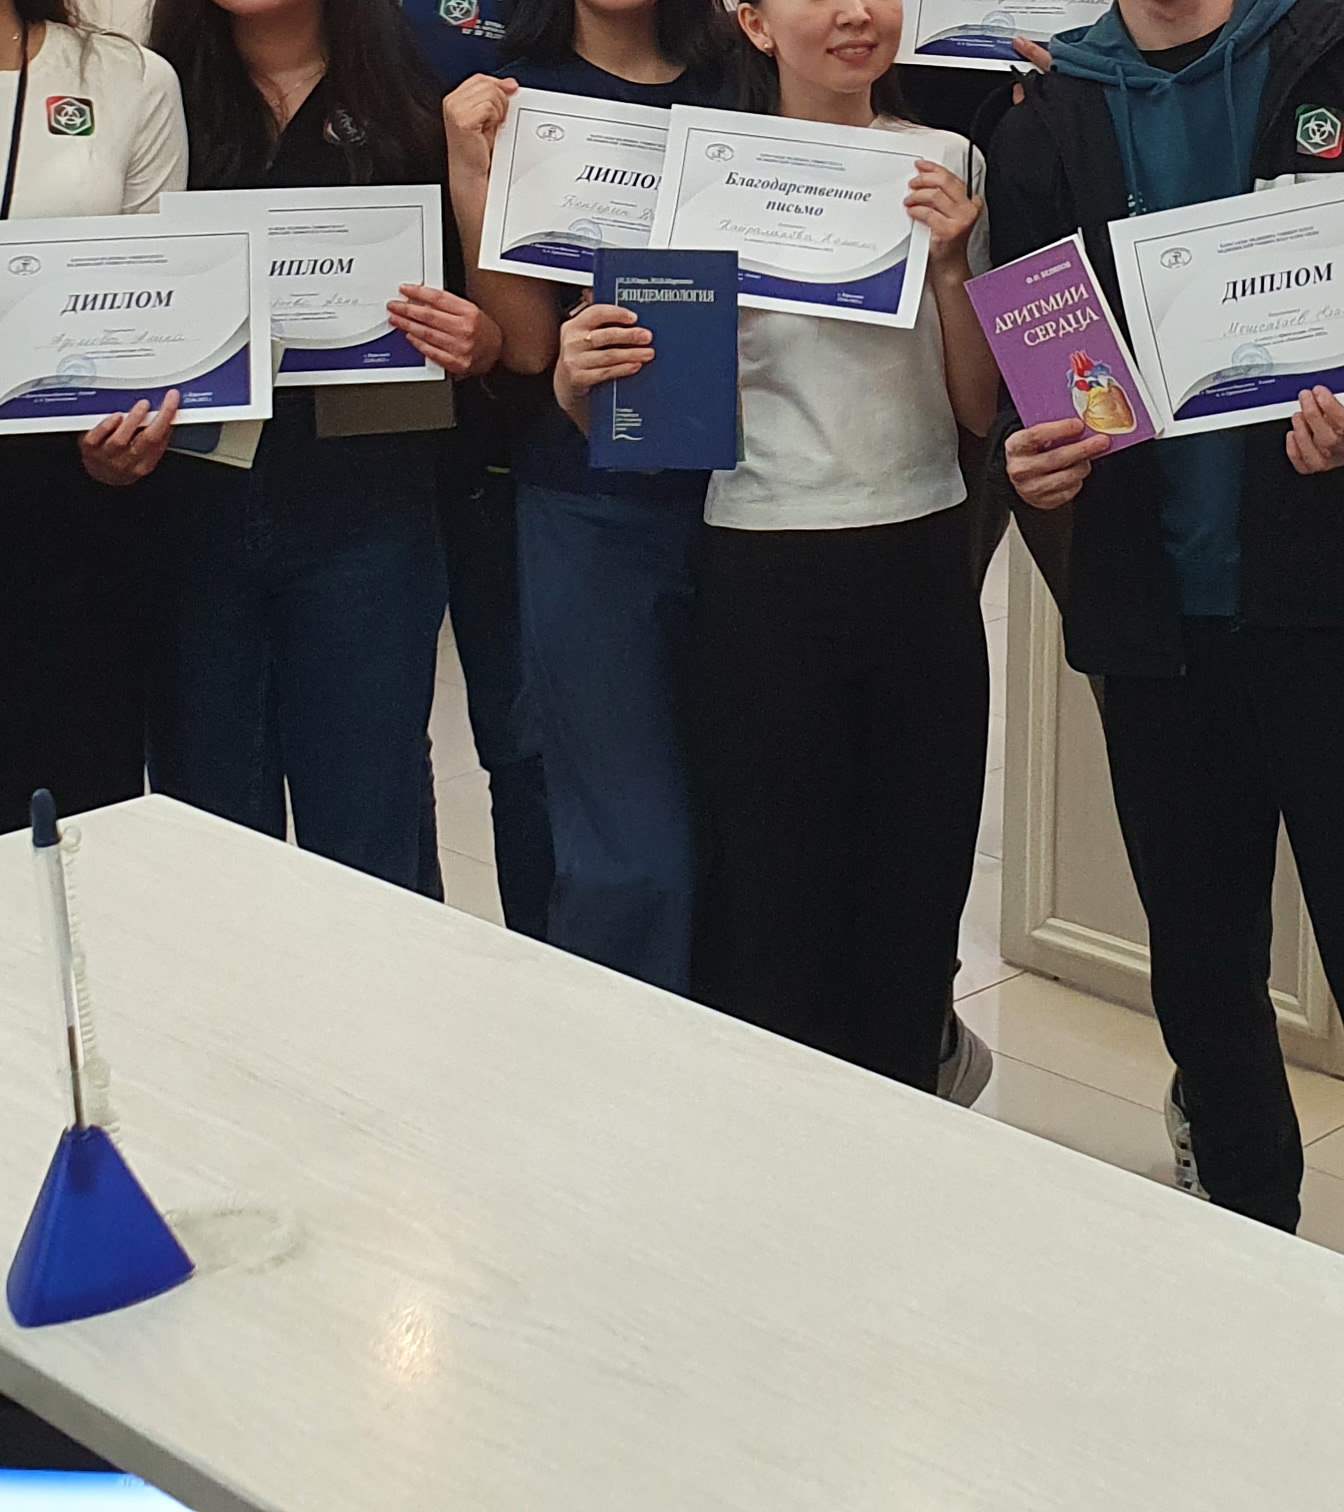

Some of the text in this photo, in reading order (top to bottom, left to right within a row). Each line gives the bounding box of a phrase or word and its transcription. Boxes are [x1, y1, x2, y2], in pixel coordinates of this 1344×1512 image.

[575, 164, 663, 191] ДИПЛО
[724, 171, 873, 203] Благодарственное
[765, 199, 825, 218] письмо
[269, 257, 355, 277] ИПЛОМ
[618, 288, 715, 303] ЭПИДЕМИОЛОГИЯ
[1221, 262, 1334, 305] ДИПЛОМ
[60, 289, 175, 316] ДИПЛОМ
[995, 282, 1090, 335] АРИТМИИ
[1023, 305, 1101, 347] СЕРДЦА
